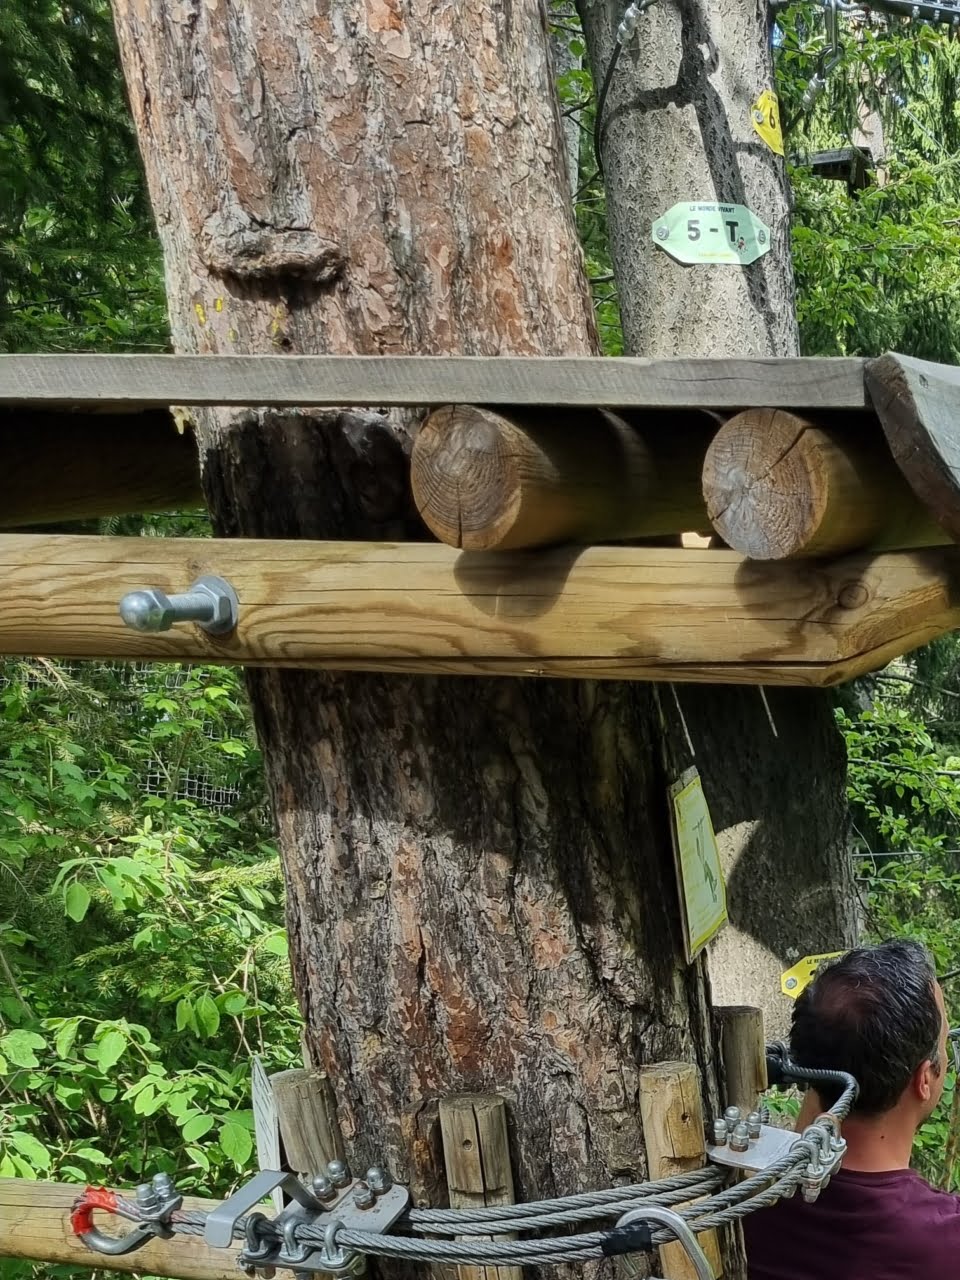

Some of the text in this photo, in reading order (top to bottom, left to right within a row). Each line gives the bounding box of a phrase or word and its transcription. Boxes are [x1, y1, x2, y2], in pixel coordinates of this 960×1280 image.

[769, 107, 776, 129] 6
[687, 219, 701, 242] 5
[725, 220, 739, 242] T
